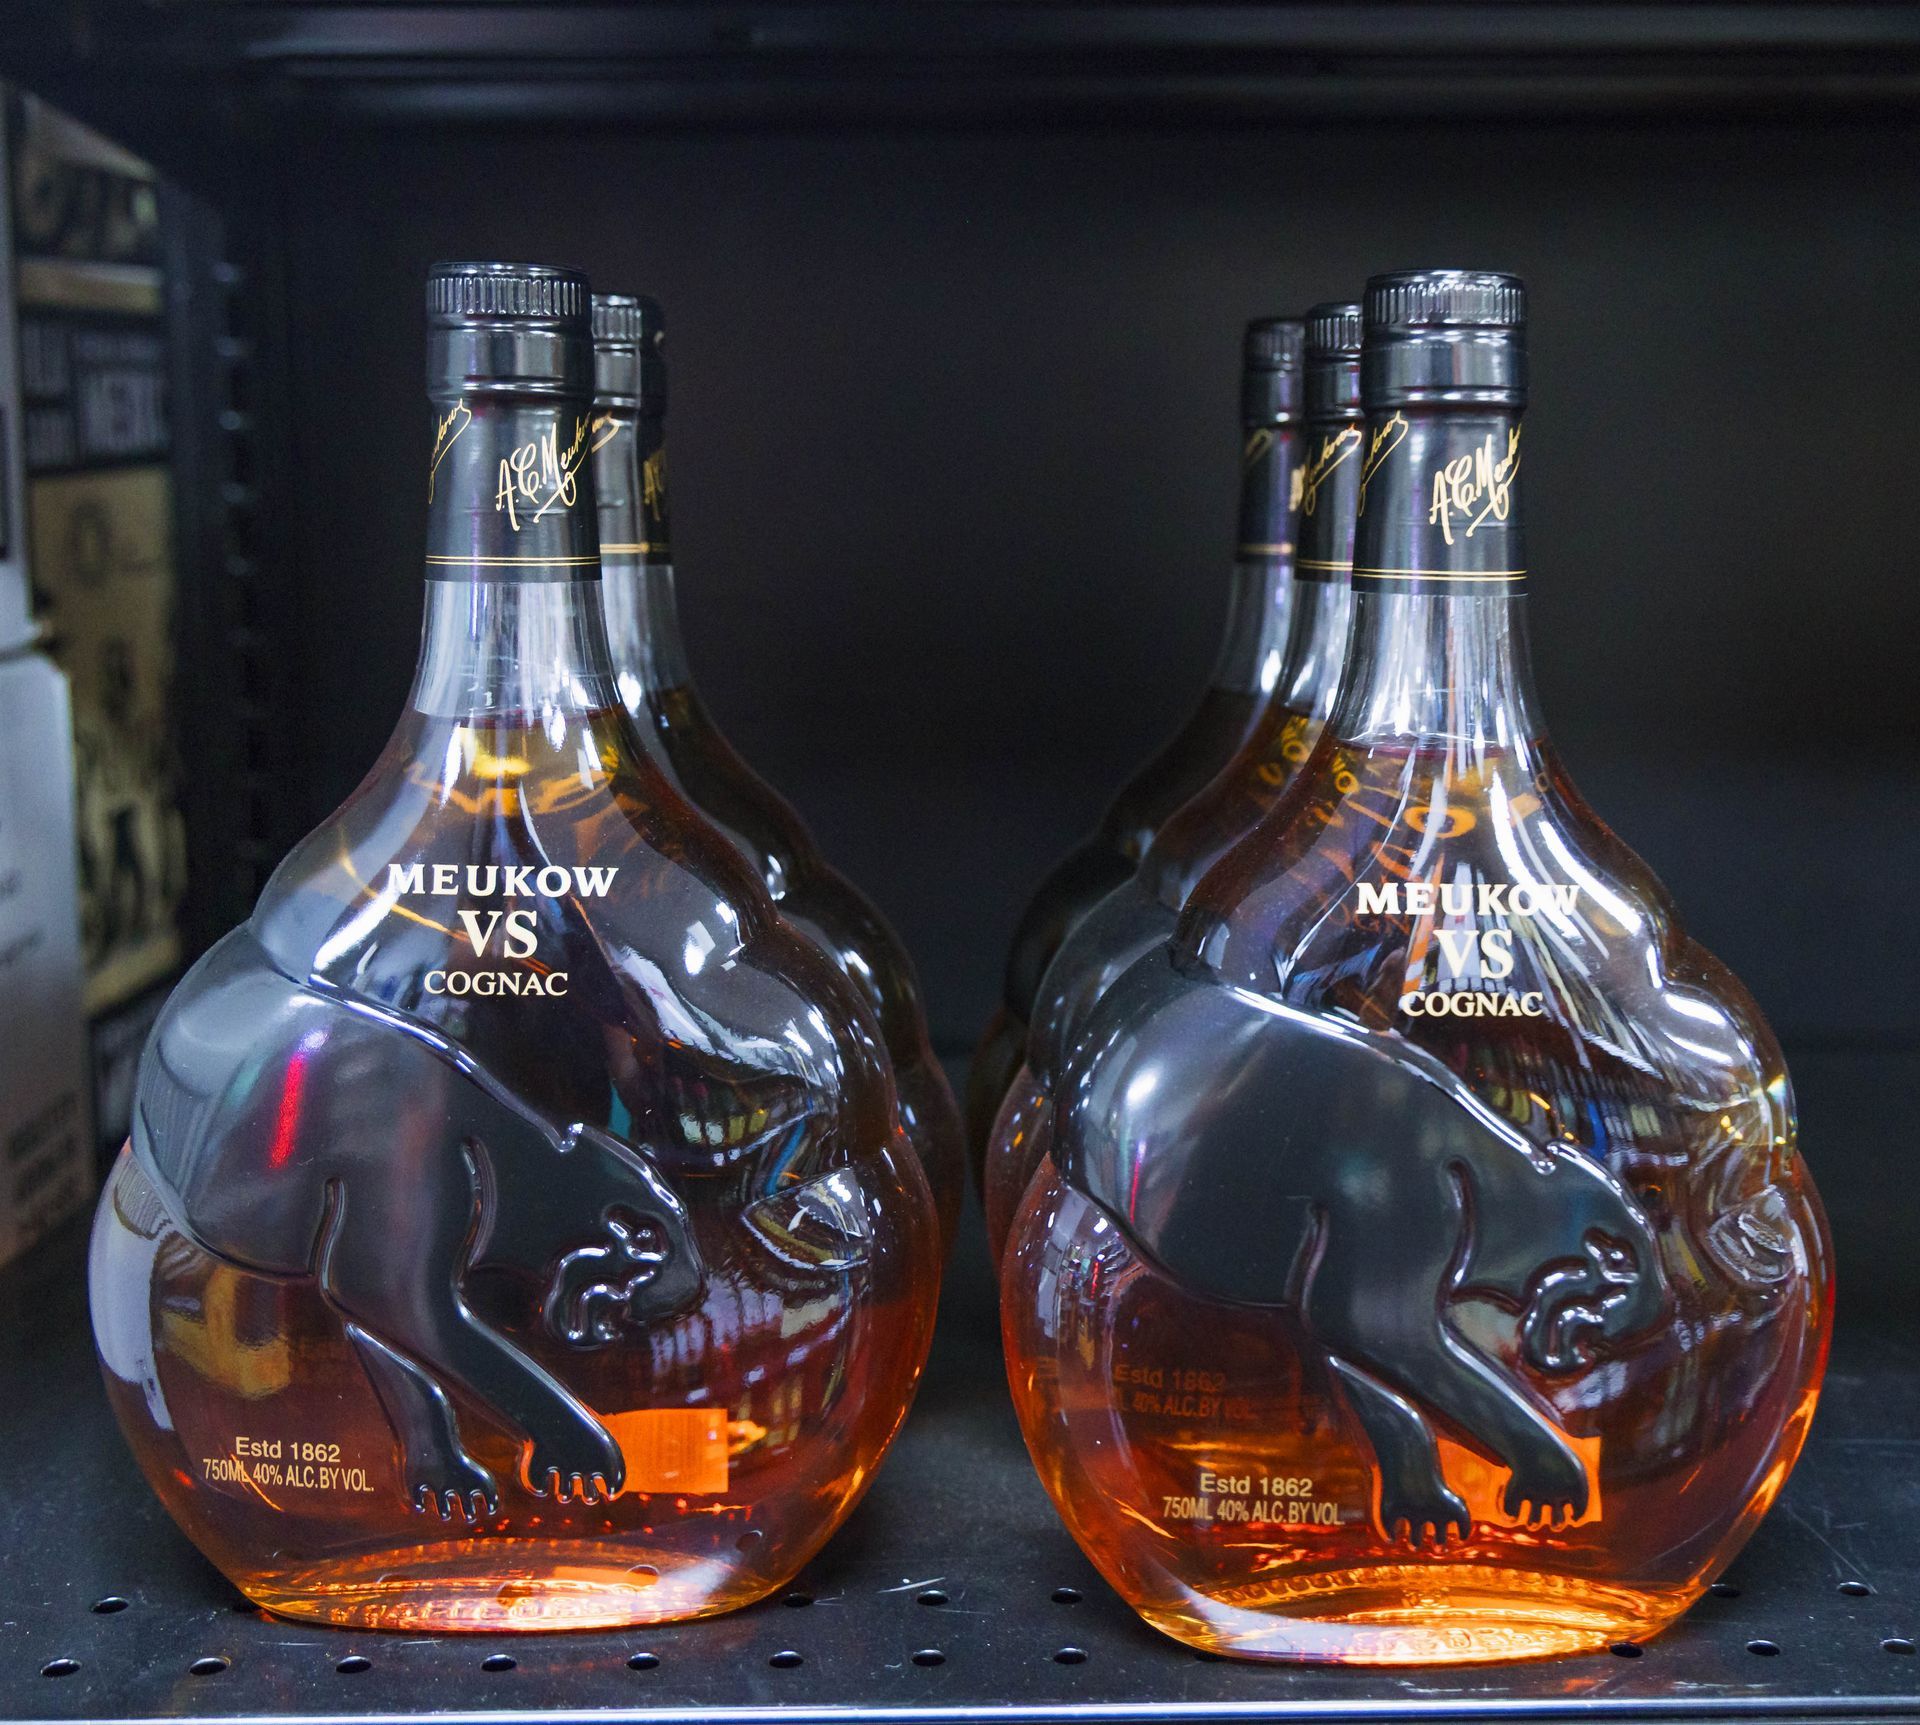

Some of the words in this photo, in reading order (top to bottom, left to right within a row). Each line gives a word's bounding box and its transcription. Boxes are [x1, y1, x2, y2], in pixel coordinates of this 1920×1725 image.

[388, 863, 619, 897] MEUKOW
[1355, 882, 1580, 916] MEUKOW
[457, 910, 538, 959] VS
[1433, 929, 1514, 979] VS
[424, 970, 568, 996] COGNAC
[1403, 991, 1543, 1017] COGNAC
[235, 1436, 281, 1458] Estd
[290, 1442, 340, 1462] 1862
[203, 1458, 250, 1482] 750ML
[253, 1463, 283, 1485] 40%
[341, 1469, 374, 1491] VOL.
[1200, 1473, 1249, 1494] Estd
[1259, 1477, 1312, 1497] 1862
[1163, 1496, 1213, 1520] 750ML
[1217, 1499, 1249, 1522] 40%
